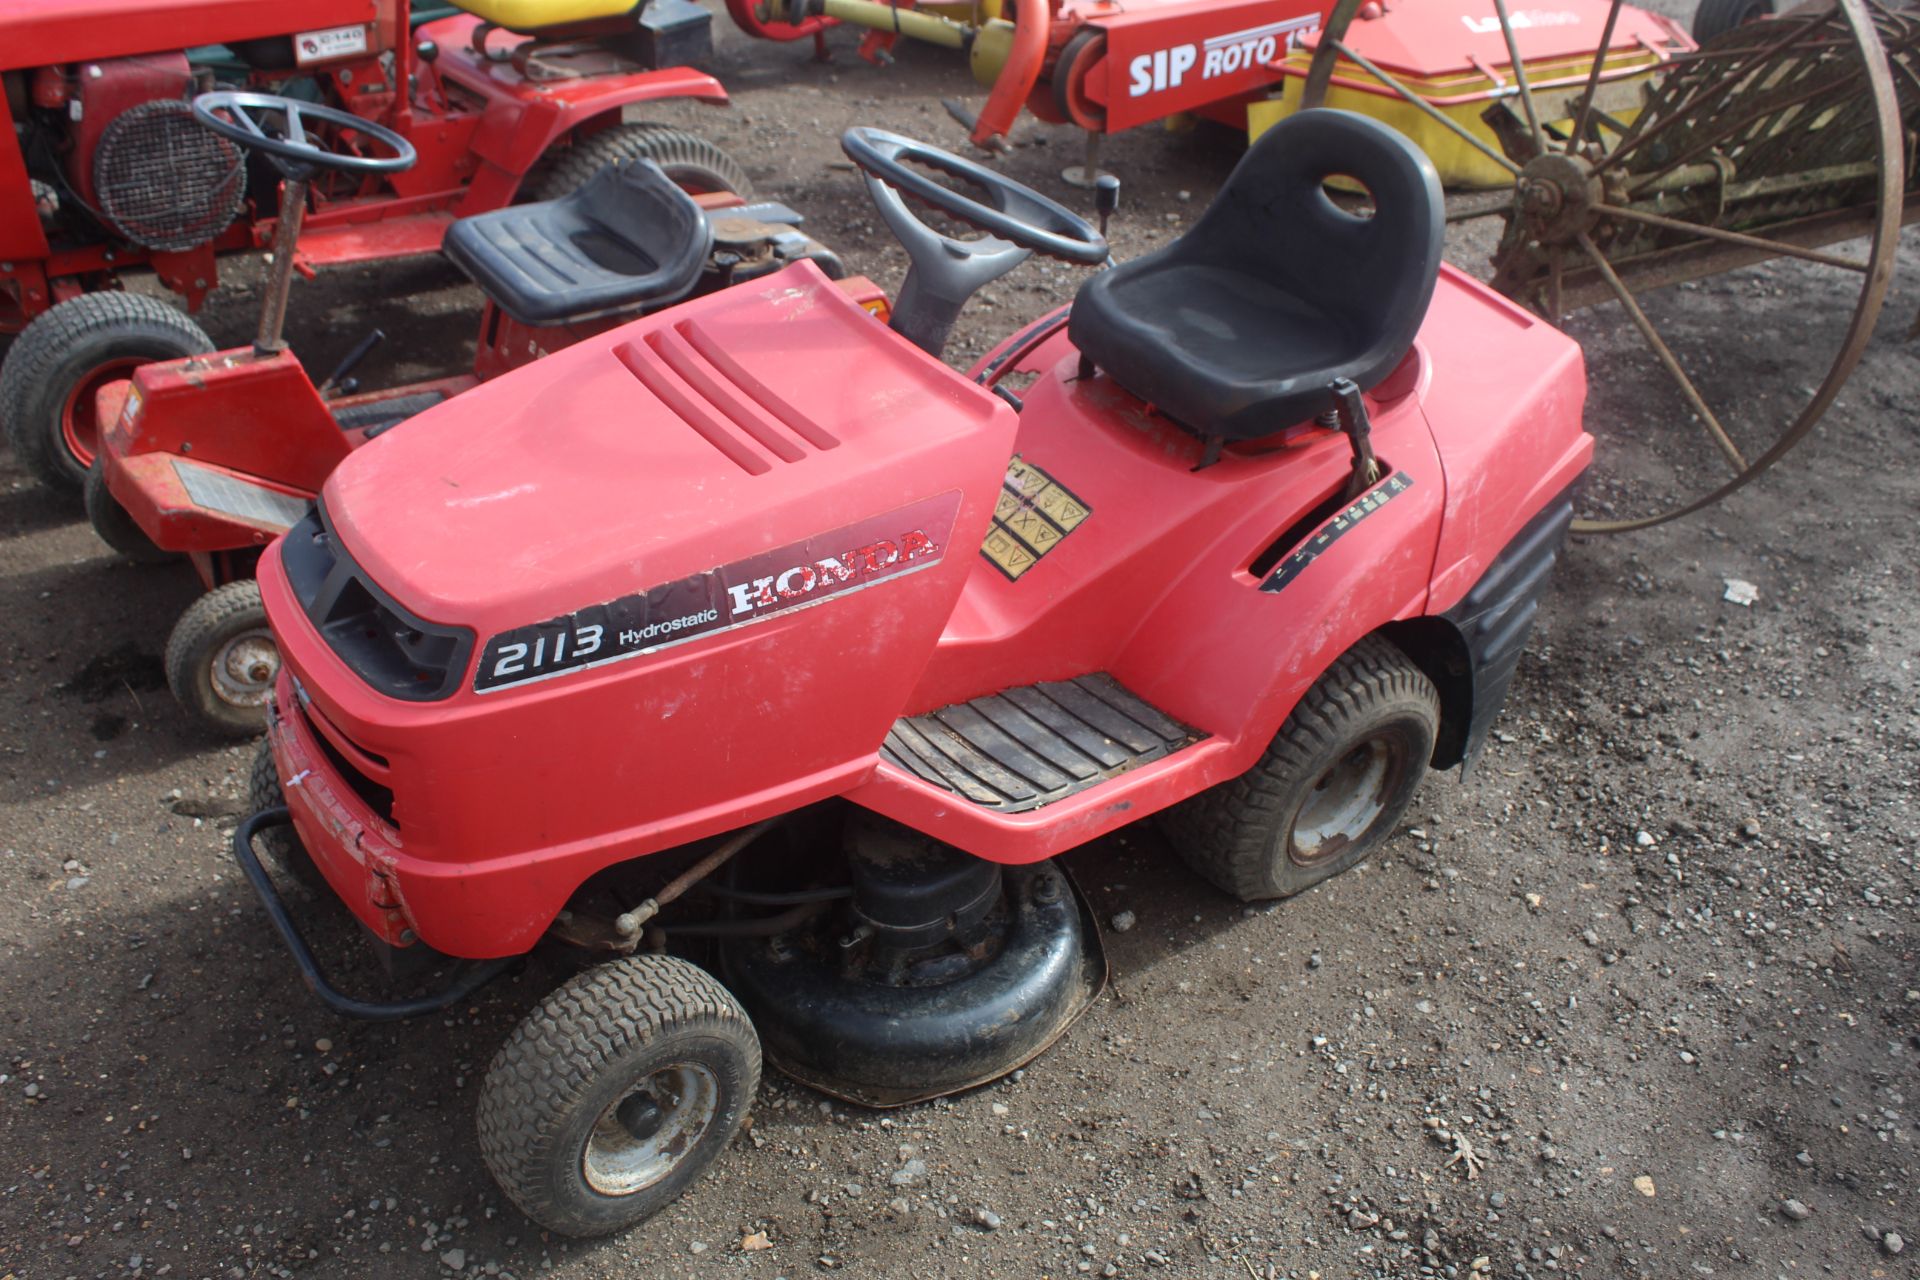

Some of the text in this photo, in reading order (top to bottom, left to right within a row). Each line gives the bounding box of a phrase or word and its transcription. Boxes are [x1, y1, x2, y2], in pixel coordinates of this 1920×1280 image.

[1129, 44, 1196, 97] SIP
[1203, 37, 1276, 79] ROTO
[493, 529, 938, 677] 2113 Hydrostatic HONDA
